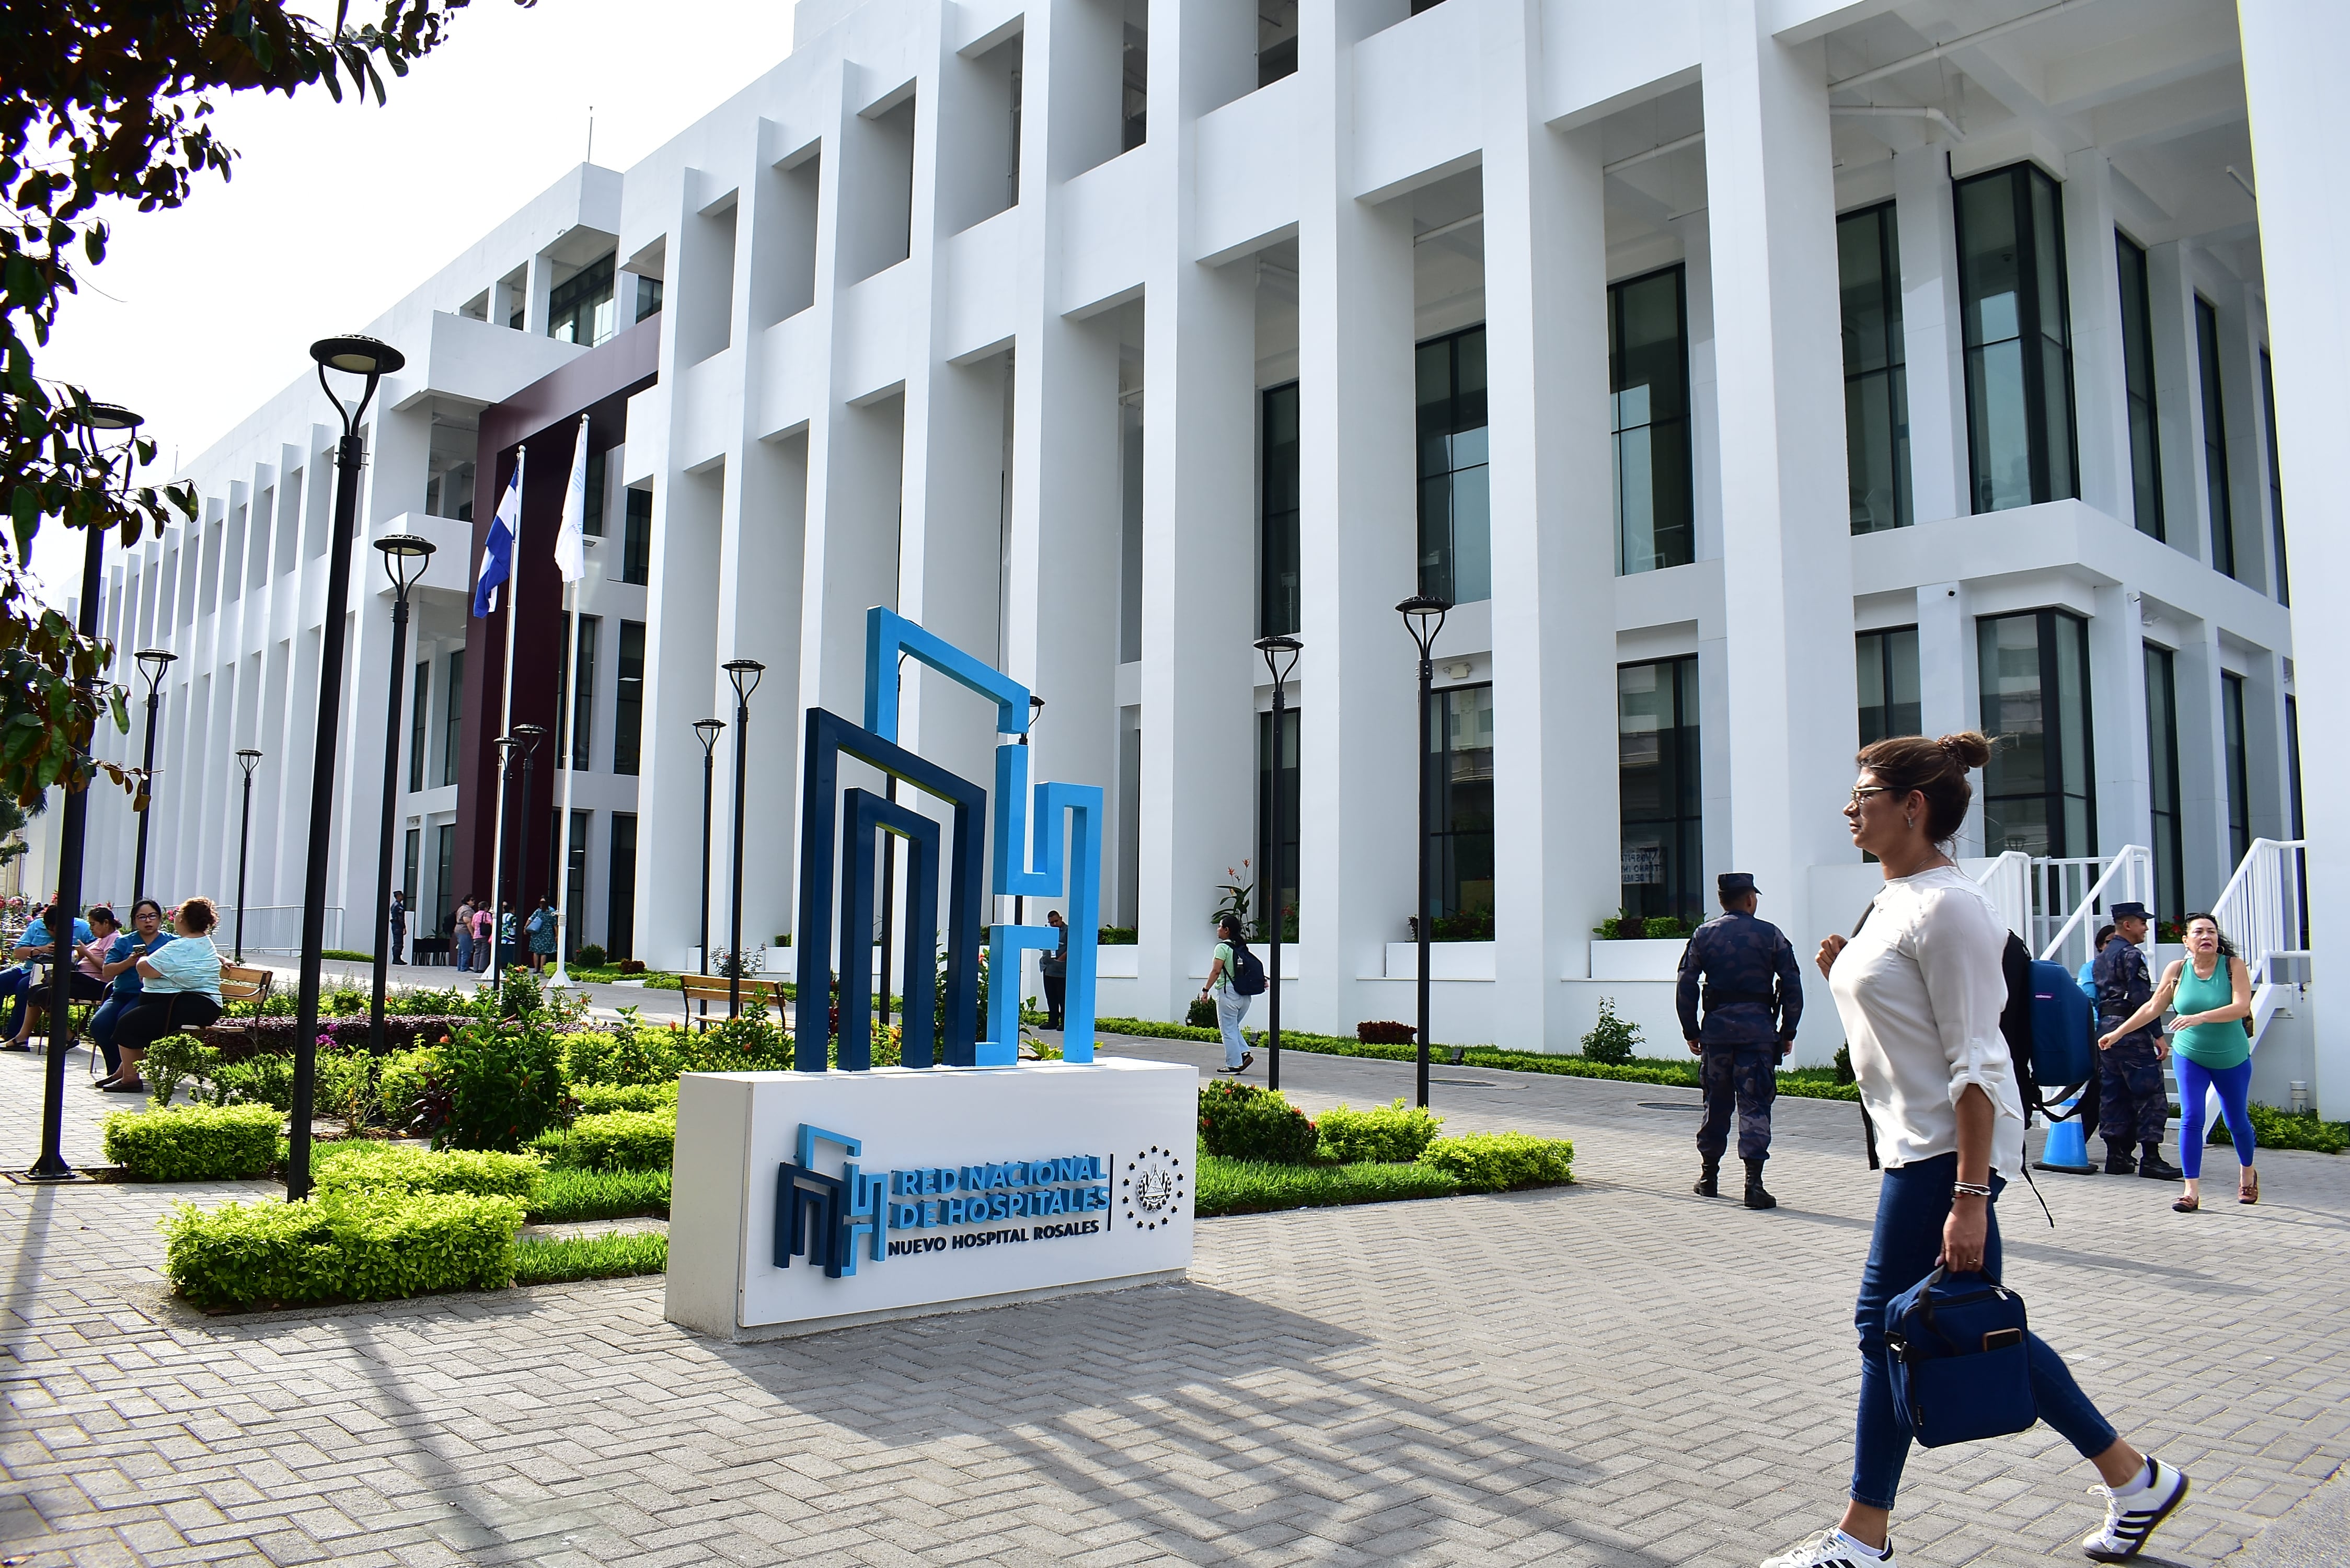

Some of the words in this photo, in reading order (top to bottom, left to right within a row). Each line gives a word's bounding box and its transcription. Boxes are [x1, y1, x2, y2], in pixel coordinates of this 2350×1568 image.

[893, 1168, 959, 1196] RED
[961, 1154, 1108, 1191] NACIONAL
[892, 1201, 938, 1229] DE
[940, 1185, 1110, 1226] HOSPITALES
[888, 1236, 947, 1256] NUEVO
[952, 1228, 1029, 1250] HOSPITAL
[1033, 1219, 1099, 1240] ROSALES
